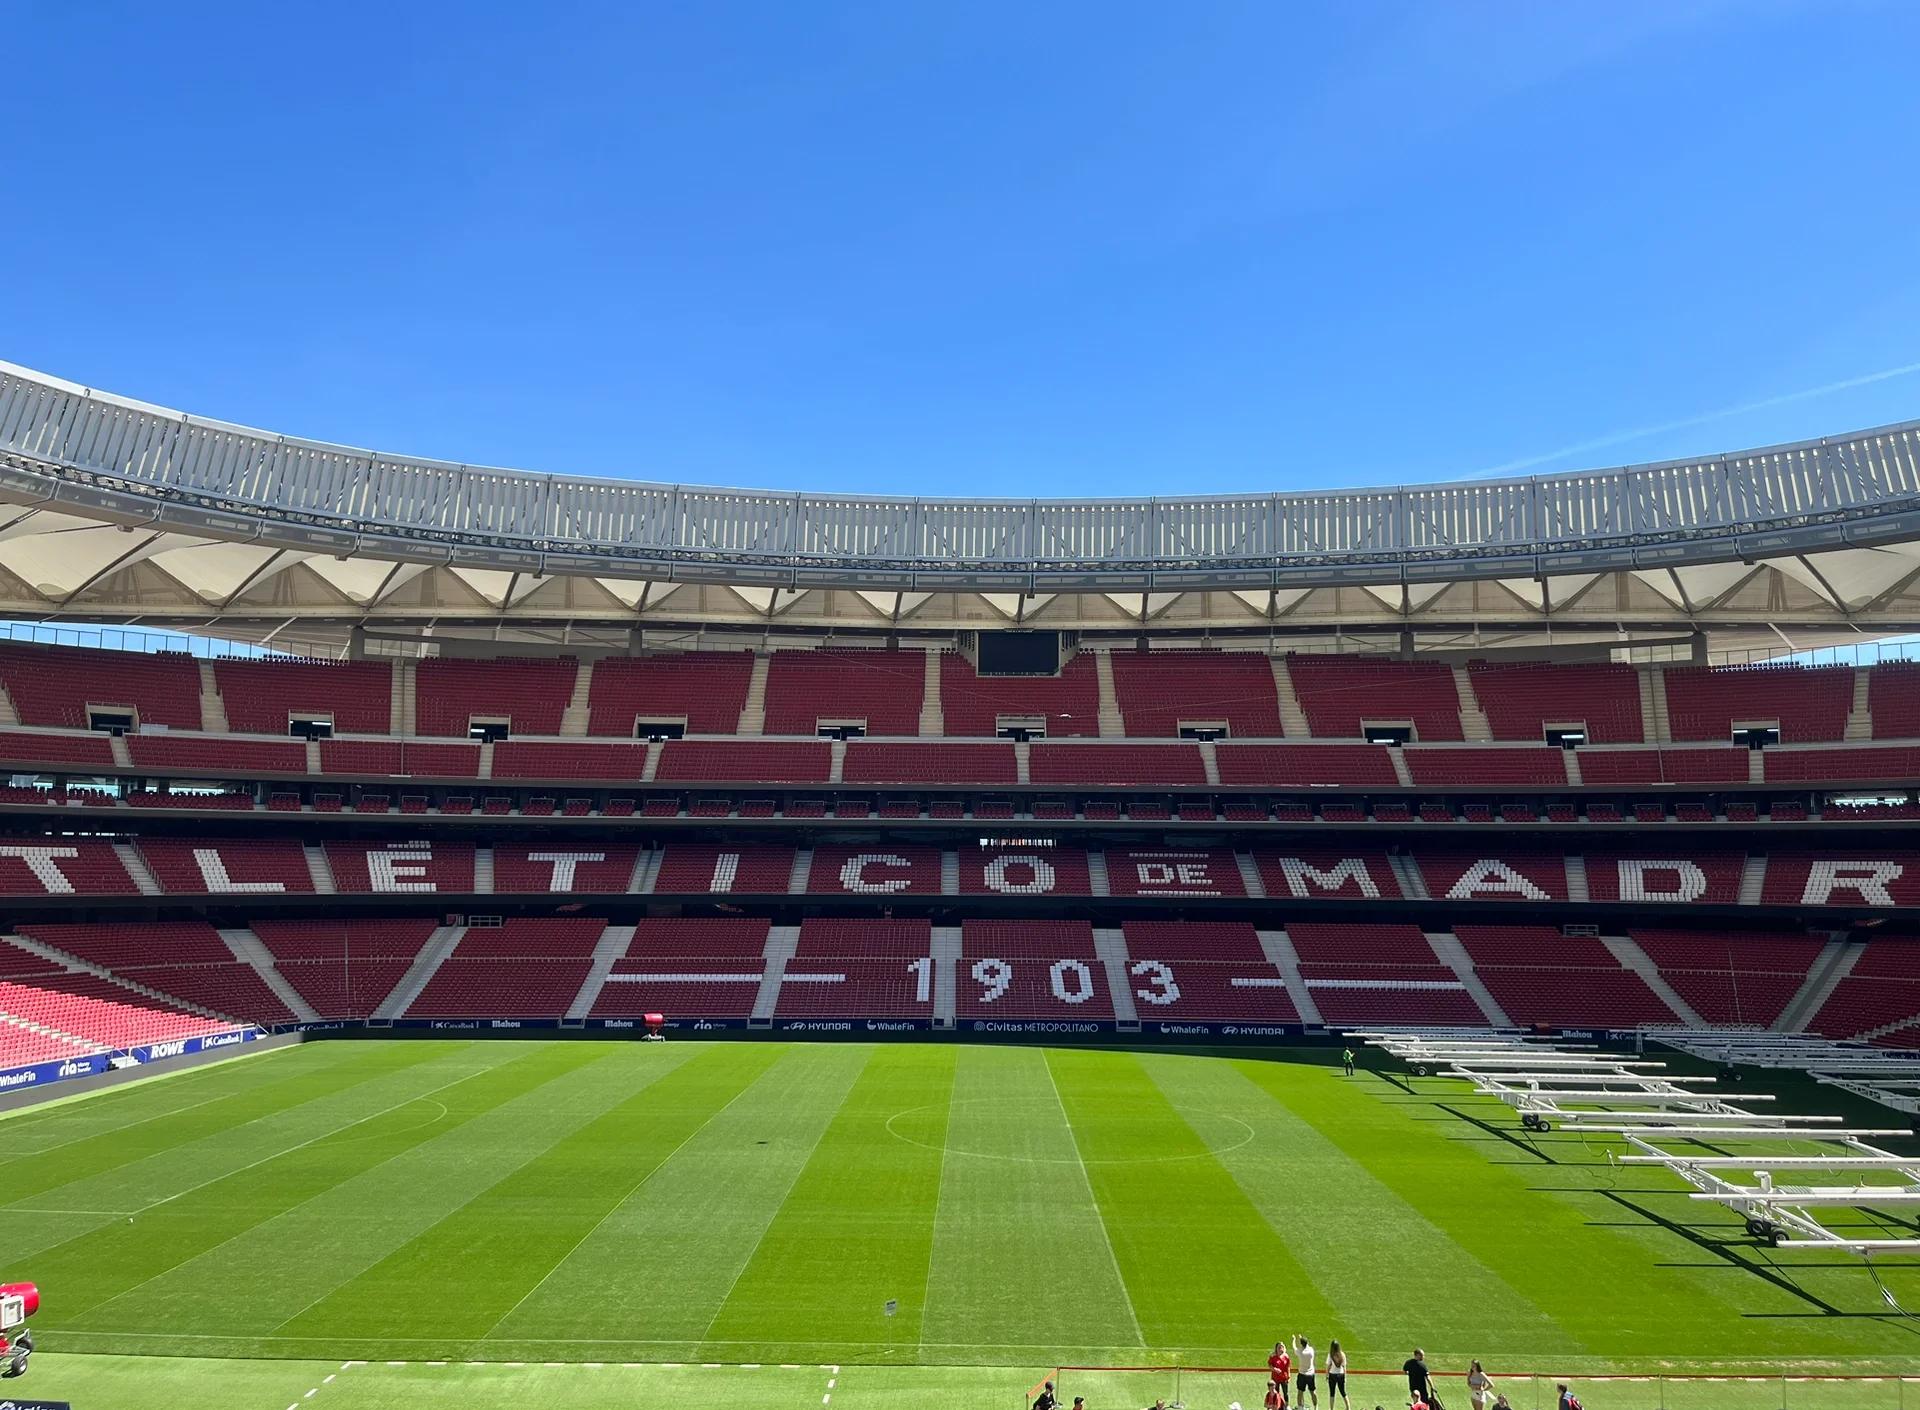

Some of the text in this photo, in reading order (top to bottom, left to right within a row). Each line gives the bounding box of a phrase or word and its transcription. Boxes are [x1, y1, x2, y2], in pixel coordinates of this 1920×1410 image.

[1136, 863, 1213, 885] DE
[808, 1022, 851, 1031] HYUNDAI
[876, 1022, 915, 1031] WhaleFin
[1024, 1022, 1099, 1033] METROPOLITANO
[1170, 1026, 1209, 1034] WhaleFin
[1240, 1027, 1285, 1036] HYUNDAI
[150, 1040, 185, 1059] ROWE
[0, 1070, 36, 1087] WhaleFin
